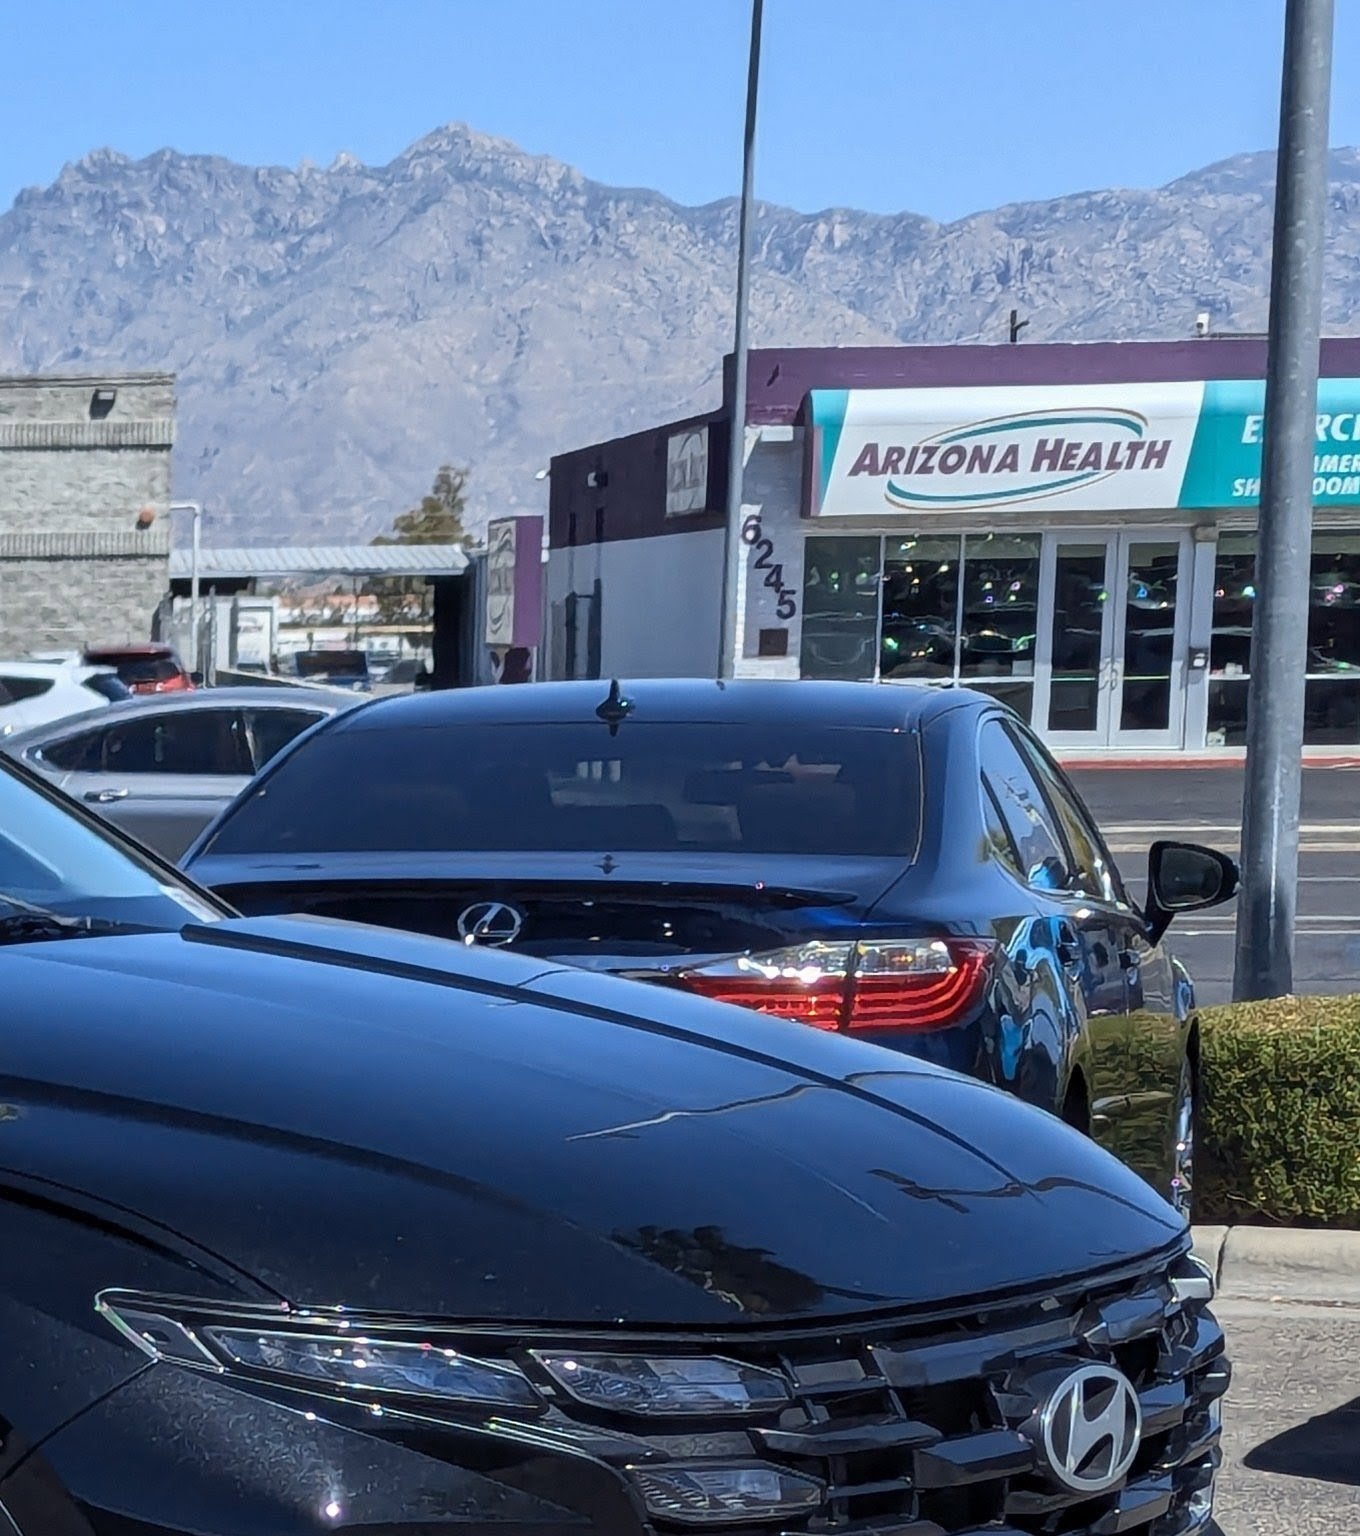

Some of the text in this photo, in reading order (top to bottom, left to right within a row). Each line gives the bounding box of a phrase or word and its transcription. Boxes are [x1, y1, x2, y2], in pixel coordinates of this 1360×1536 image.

[847, 437, 1172, 476] ARIZONA HEALTH
[742, 514, 796, 620] 6245
